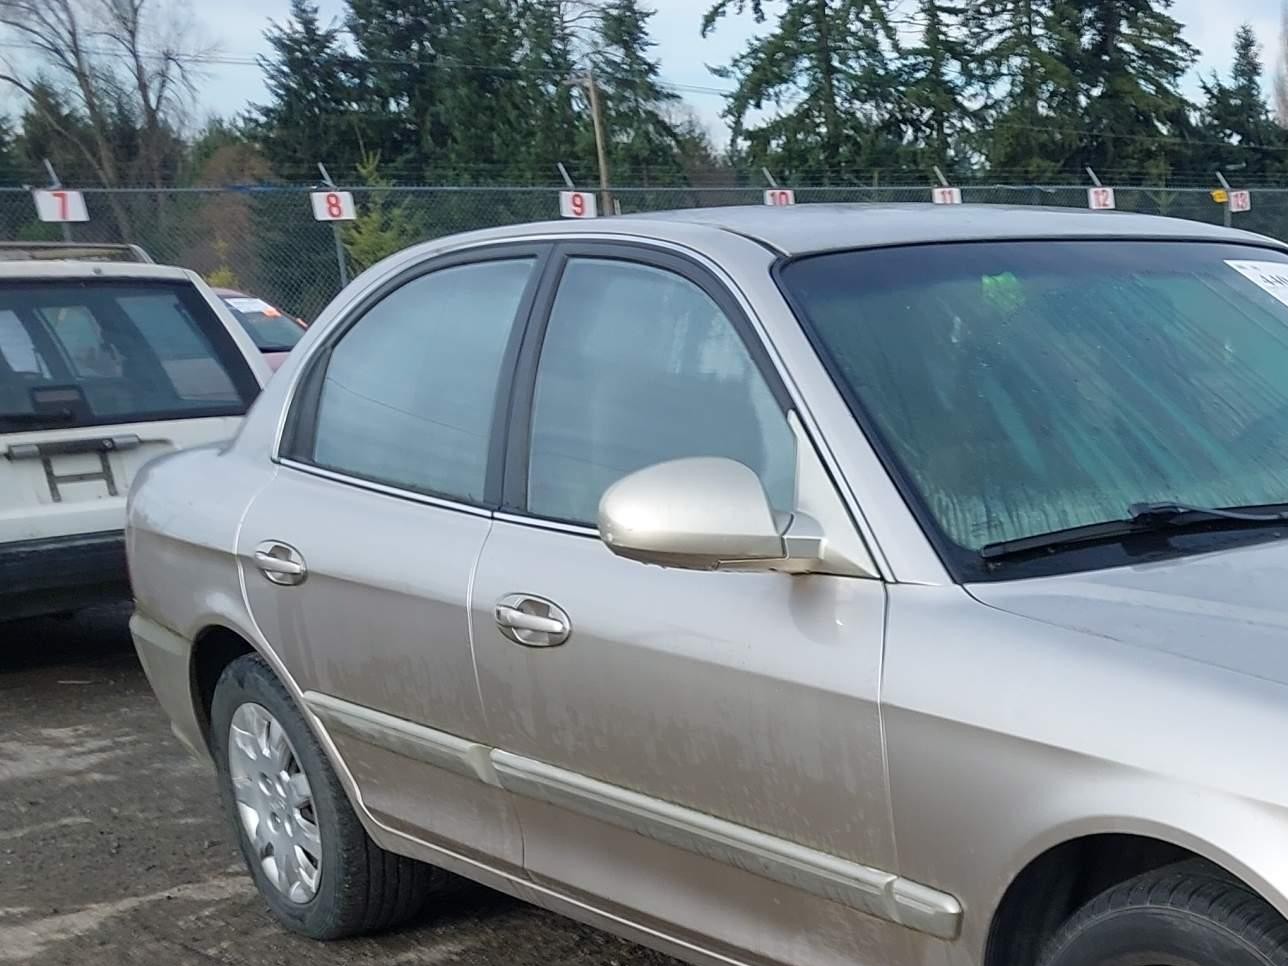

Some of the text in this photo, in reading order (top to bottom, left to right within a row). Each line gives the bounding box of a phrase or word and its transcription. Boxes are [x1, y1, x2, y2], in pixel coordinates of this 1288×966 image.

[52, 191, 69, 221] 7
[326, 193, 343, 218] 8
[571, 193, 585, 217] 9
[940, 190, 955, 205] 11
[1093, 189, 1110, 208] 12
